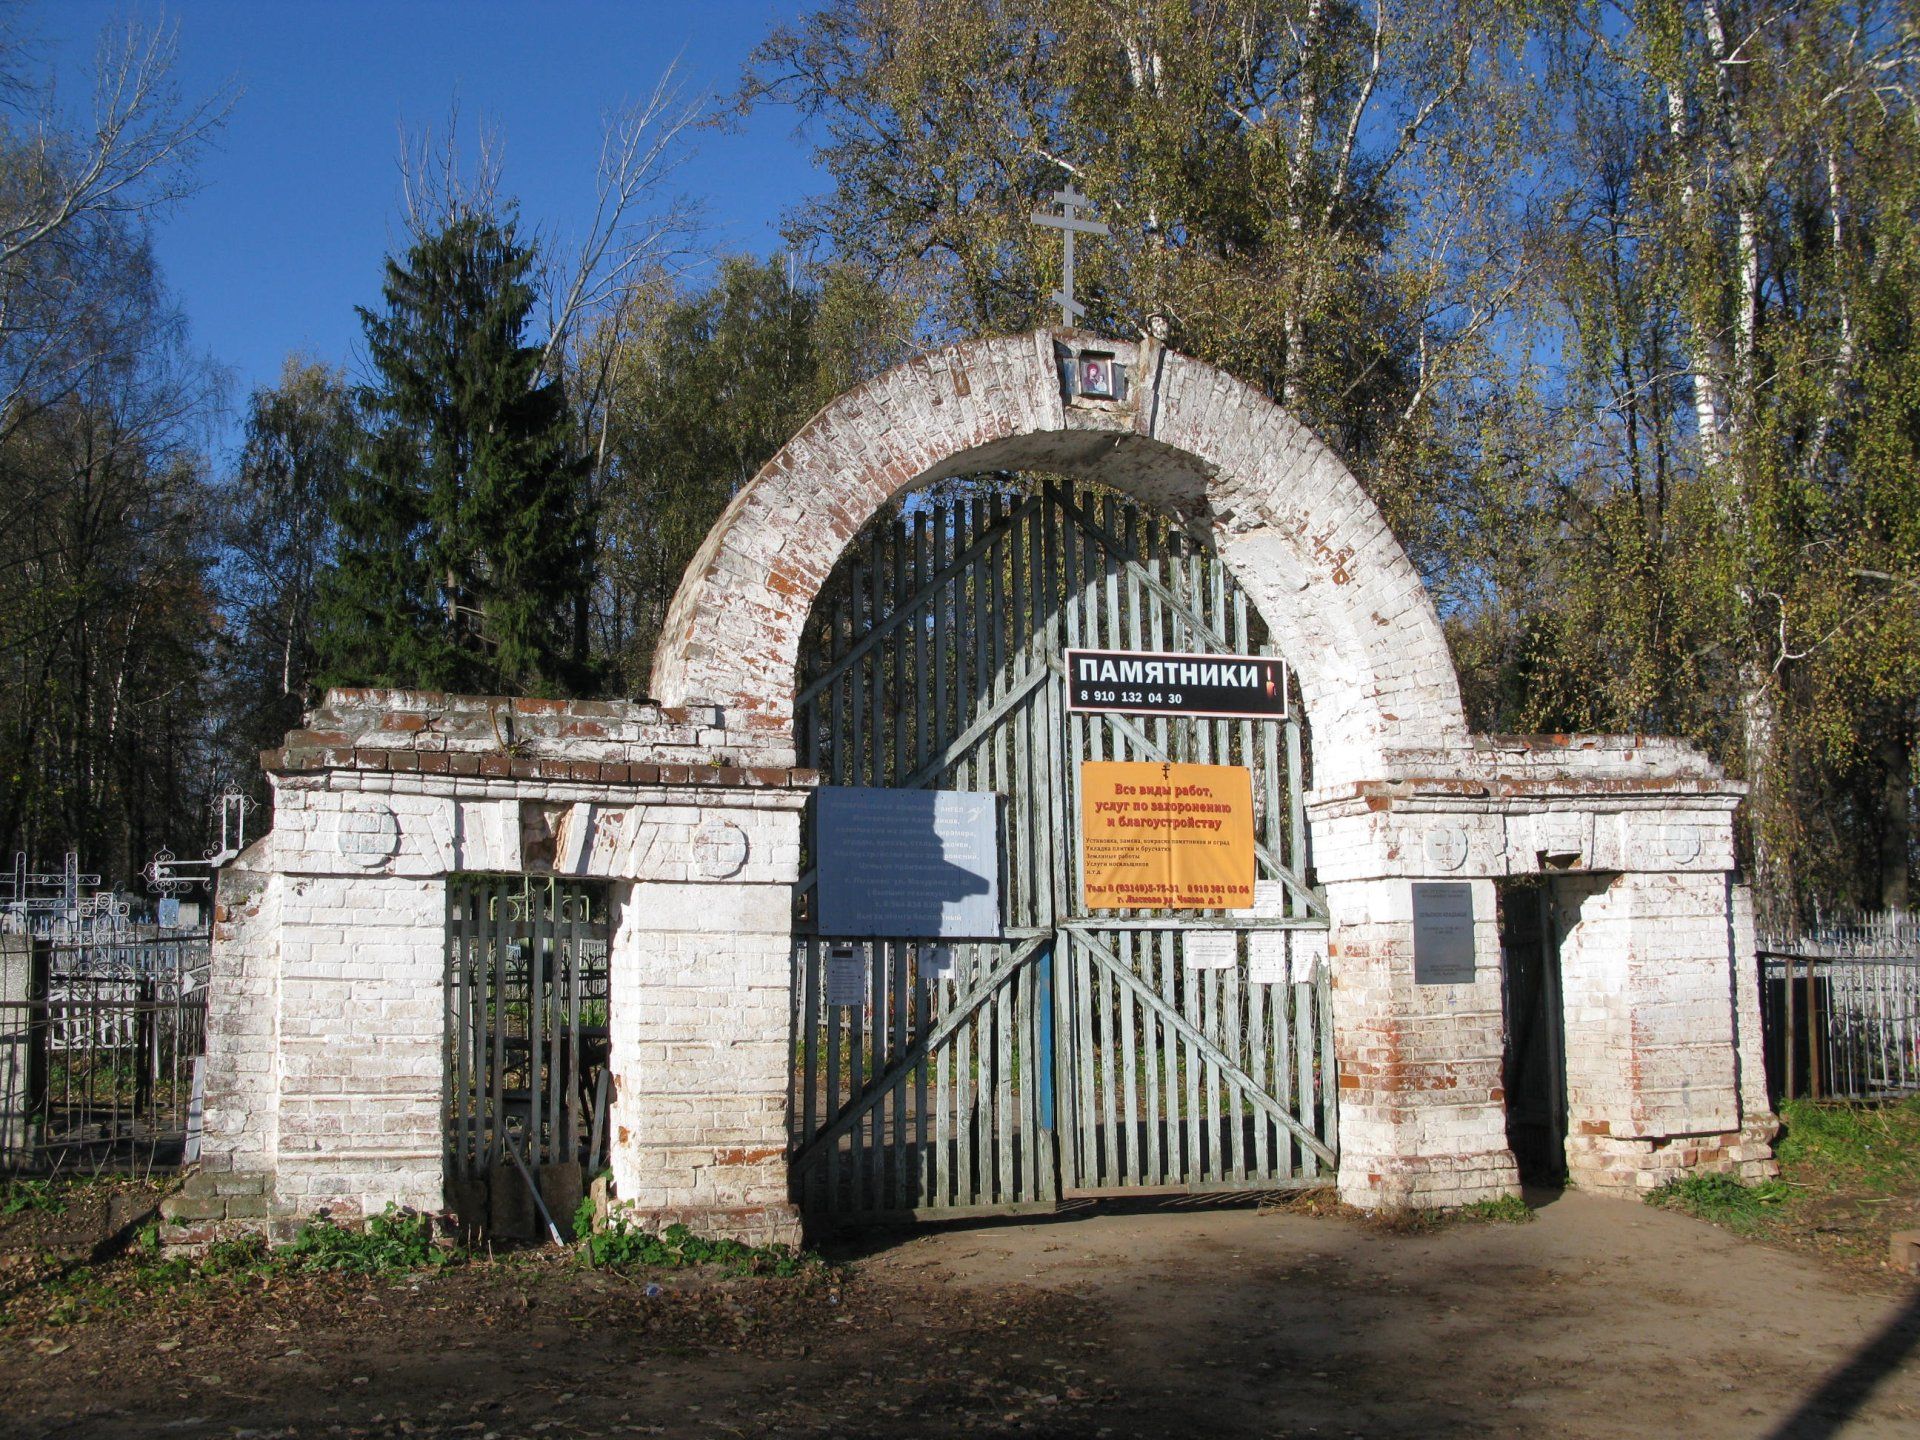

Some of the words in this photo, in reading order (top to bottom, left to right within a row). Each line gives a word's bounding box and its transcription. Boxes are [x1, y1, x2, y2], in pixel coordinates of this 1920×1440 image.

[1079, 658, 1259, 688] ПАМЯТНИКИ
[1080, 690, 1088, 701] 8
[1094, 691, 1115, 702] 910
[1121, 691, 1142, 703] 132
[1148, 692, 1162, 704] 04
[1168, 693, 1182, 704] 30
[1114, 783, 1136, 795] Все
[1139, 785, 1172, 798] виды
[1175, 785, 1213, 799] работ,
[1095, 801, 1130, 813] услуг
[1132, 802, 1148, 811] по
[1151, 802, 1232, 814] захоронению
[1107, 817, 1115, 827] и
[1118, 815, 1223, 831] благоустройству
